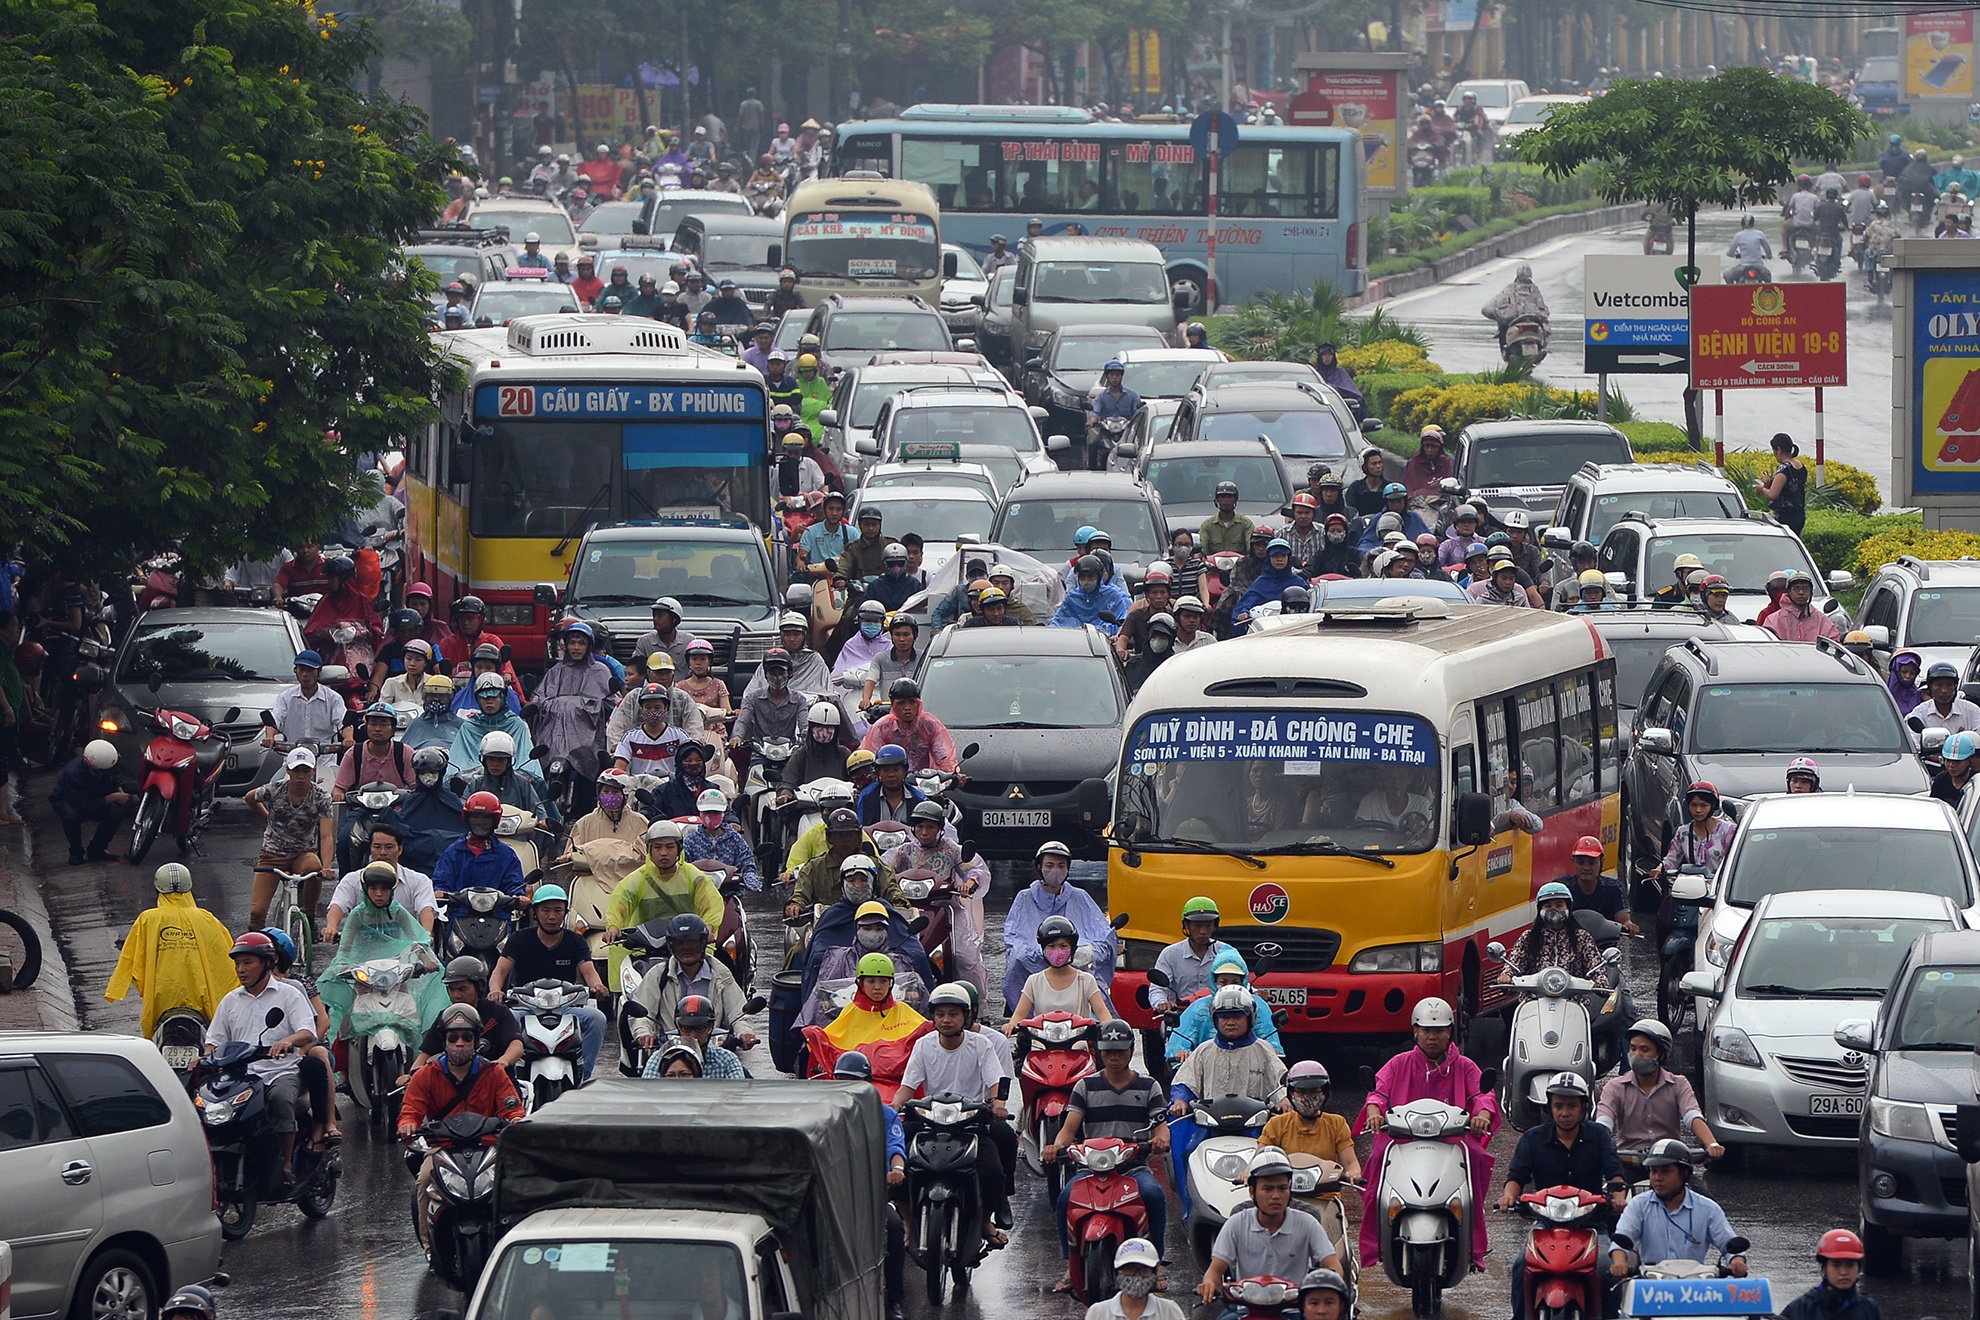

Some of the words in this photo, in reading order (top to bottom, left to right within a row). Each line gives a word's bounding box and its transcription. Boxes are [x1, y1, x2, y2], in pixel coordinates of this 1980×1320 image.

[1001, 138, 1060, 160] TP.THÁI
[1062, 139, 1100, 161] BÌNH
[1126, 141, 1151, 162] MỸ
[1156, 141, 1194, 163] ĐÌNH
[1137, 224, 1188, 243] THIÊN
[1594, 291, 1688, 307] Vietcomba
[1931, 290, 1966, 303] TẤM
[1648, 324, 1670, 332] NGÂN
[1741, 317, 1753, 327] BỘ
[1756, 316, 1781, 325] CÔNG
[1784, 317, 1796, 325] AN
[1928, 313, 1980, 338] OLY
[1699, 329, 1748, 359] BỆNH
[1754, 328, 1796, 358] VIỆN
[1802, 332, 1839, 354] 19-8
[1929, 343, 1952, 352] MÁI
[501, 388, 533, 415] 20
[542, 387, 579, 412] CẦU
[586, 387, 630, 412] GIẤY
[649, 393, 674, 412] BX
[681, 390, 745, 413] PHÙNG
[1149, 718, 1181, 743] MỸ
[1186, 716, 1235, 741] ĐÌNH
[1250, 716, 1278, 741] ĐÁ
[1286, 716, 1357, 743] CHÔNG
[1374, 723, 1414, 749] CHẸ
[1134, 747, 1157, 761] SƠN
[1159, 745, 1180, 759] TÂY
[1190, 743, 1216, 760] VIỆN
[1218, 746, 1226, 758] 5
[1234, 743, 1266, 758] XUÂN
[1268, 745, 1308, 758] KHANH
[1318, 743, 1340, 759] TẢN
[1344, 745, 1371, 760] LĨNH
[1381, 749, 1397, 761] BA
[1400, 750, 1426, 765] TRẠI
[984, 812, 1049, 825] 30A-141.78
[1270, 990, 1306, 1004] 54.65
[1813, 1098, 1863, 1113] 29A-60
[1642, 1286, 1674, 1310] Vạn
[1680, 1286, 1723, 1304] Xuân
[1727, 1284, 1762, 1304] Taxi
